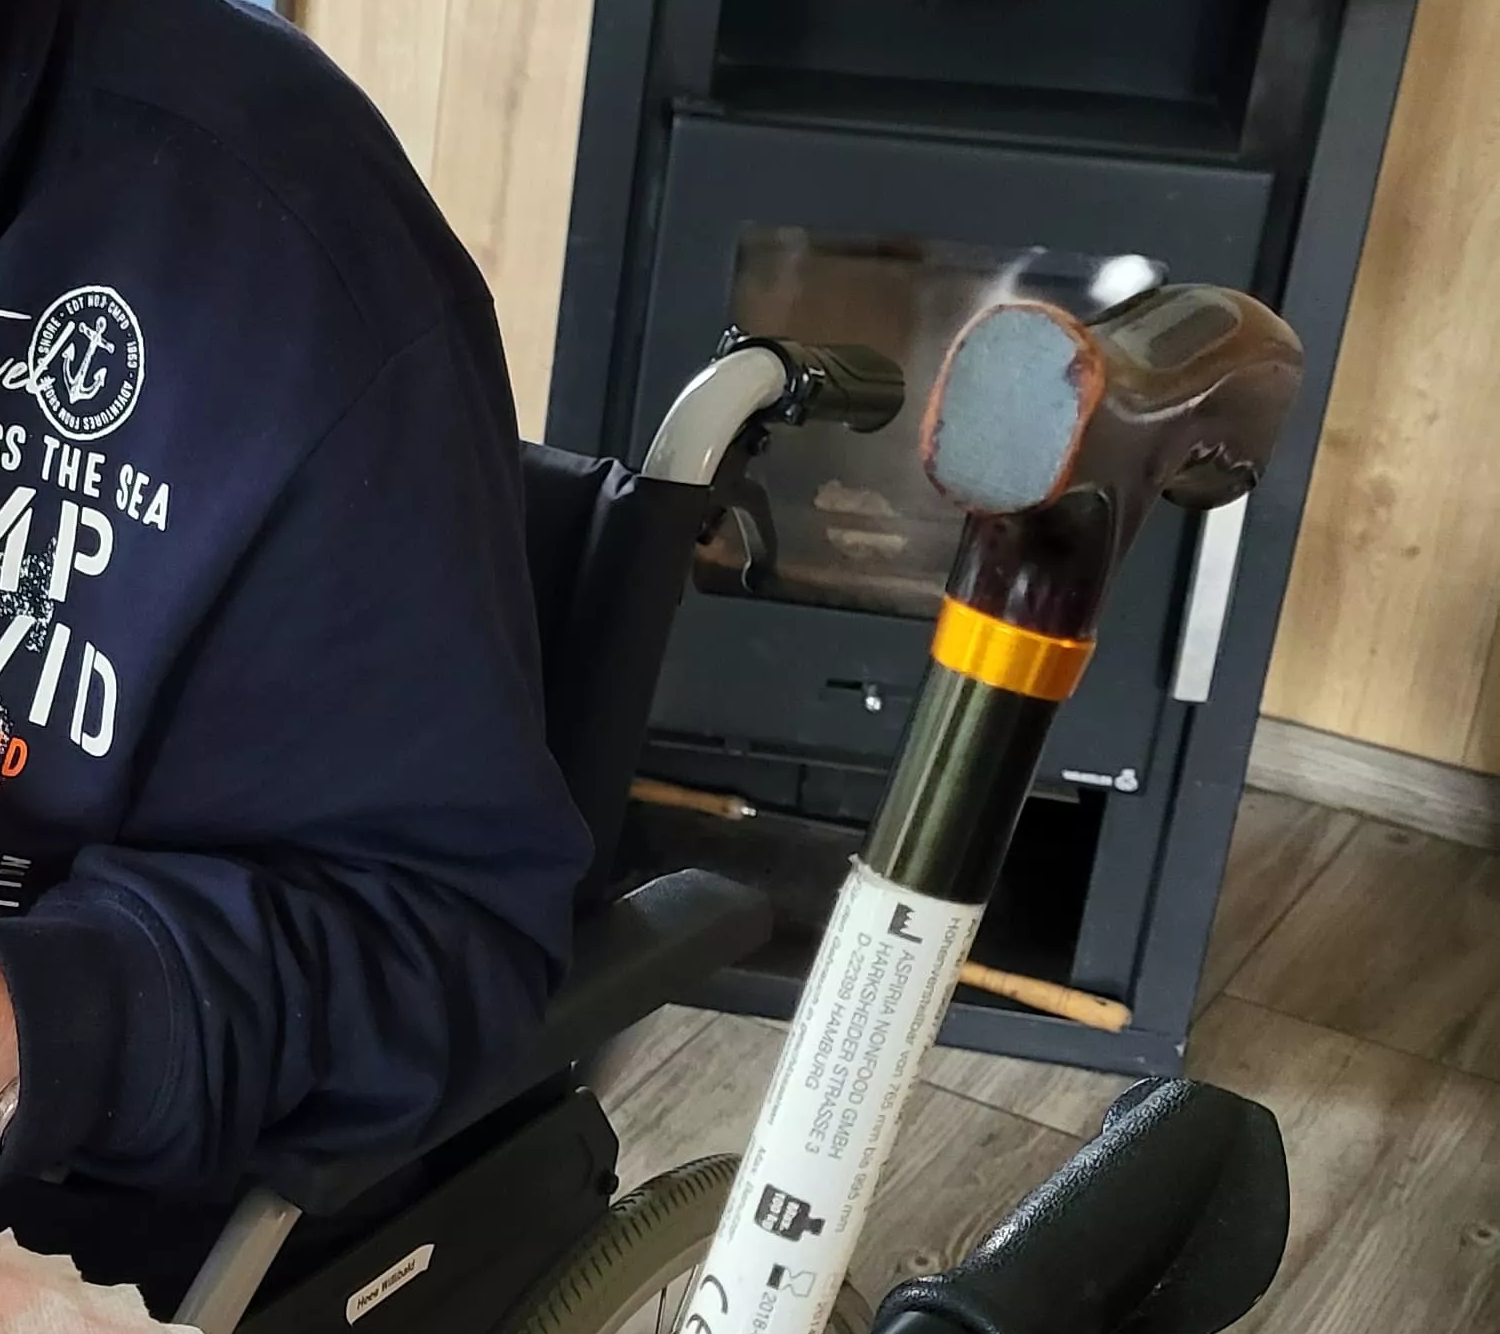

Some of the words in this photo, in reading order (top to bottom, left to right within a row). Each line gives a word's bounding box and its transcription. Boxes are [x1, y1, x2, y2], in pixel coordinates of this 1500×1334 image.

[58, 407, 80, 430] FROM
[83, 380, 134, 431] ADVENTURES
[41, 435, 107, 498] THE
[115, 463, 171, 532] SEA
[835, 931, 873, 1001] D-22399
[878, 948, 916, 1017] ASPIRIA
[836, 940, 894, 1063] HARKSHEIDER
[803, 1002, 848, 1091] HAMBURG
[846, 1018, 891, 1106] NONFOOD
[892, 1049, 911, 1078] von
[807, 1062, 849, 1141] STRASSE
[826, 1105, 859, 1161] GMBH
[803, 1140, 820, 1155] 3
